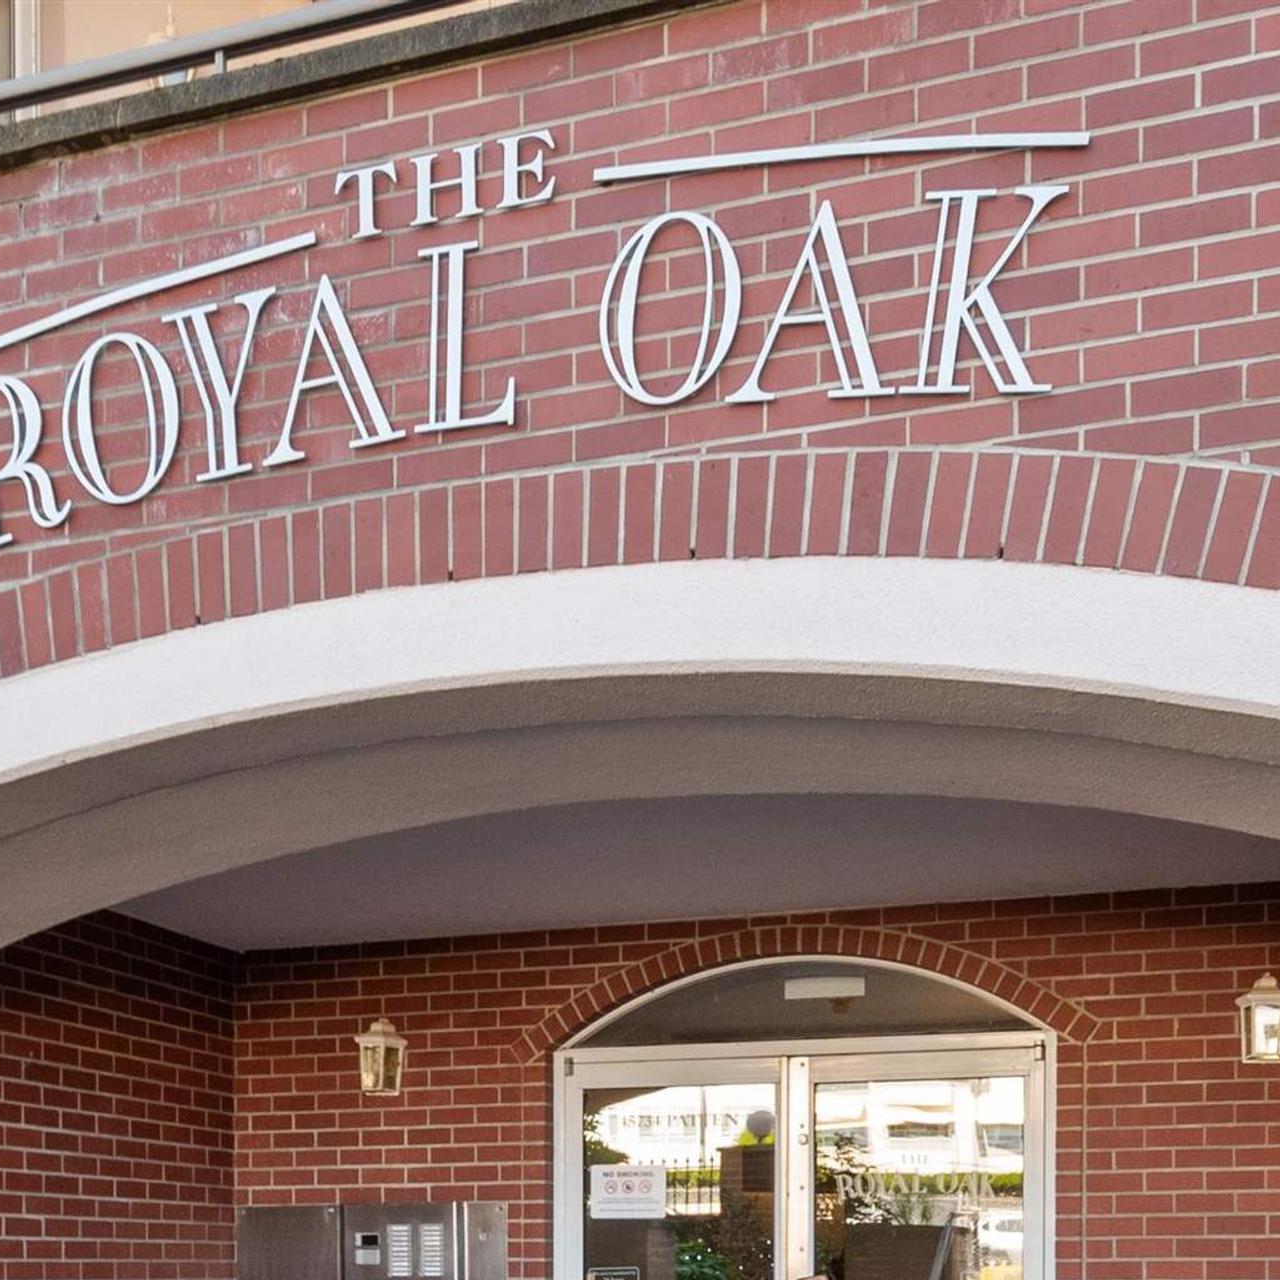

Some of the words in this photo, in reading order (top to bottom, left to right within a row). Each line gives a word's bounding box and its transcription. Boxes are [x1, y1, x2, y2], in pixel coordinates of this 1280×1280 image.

[335, 129, 558, 238] THE
[598, 184, 1070, 407] OAK
[602, 1170, 615, 1178] NO
[834, 1168, 927, 1200] ROYAL
[936, 1169, 996, 1199] OAK
